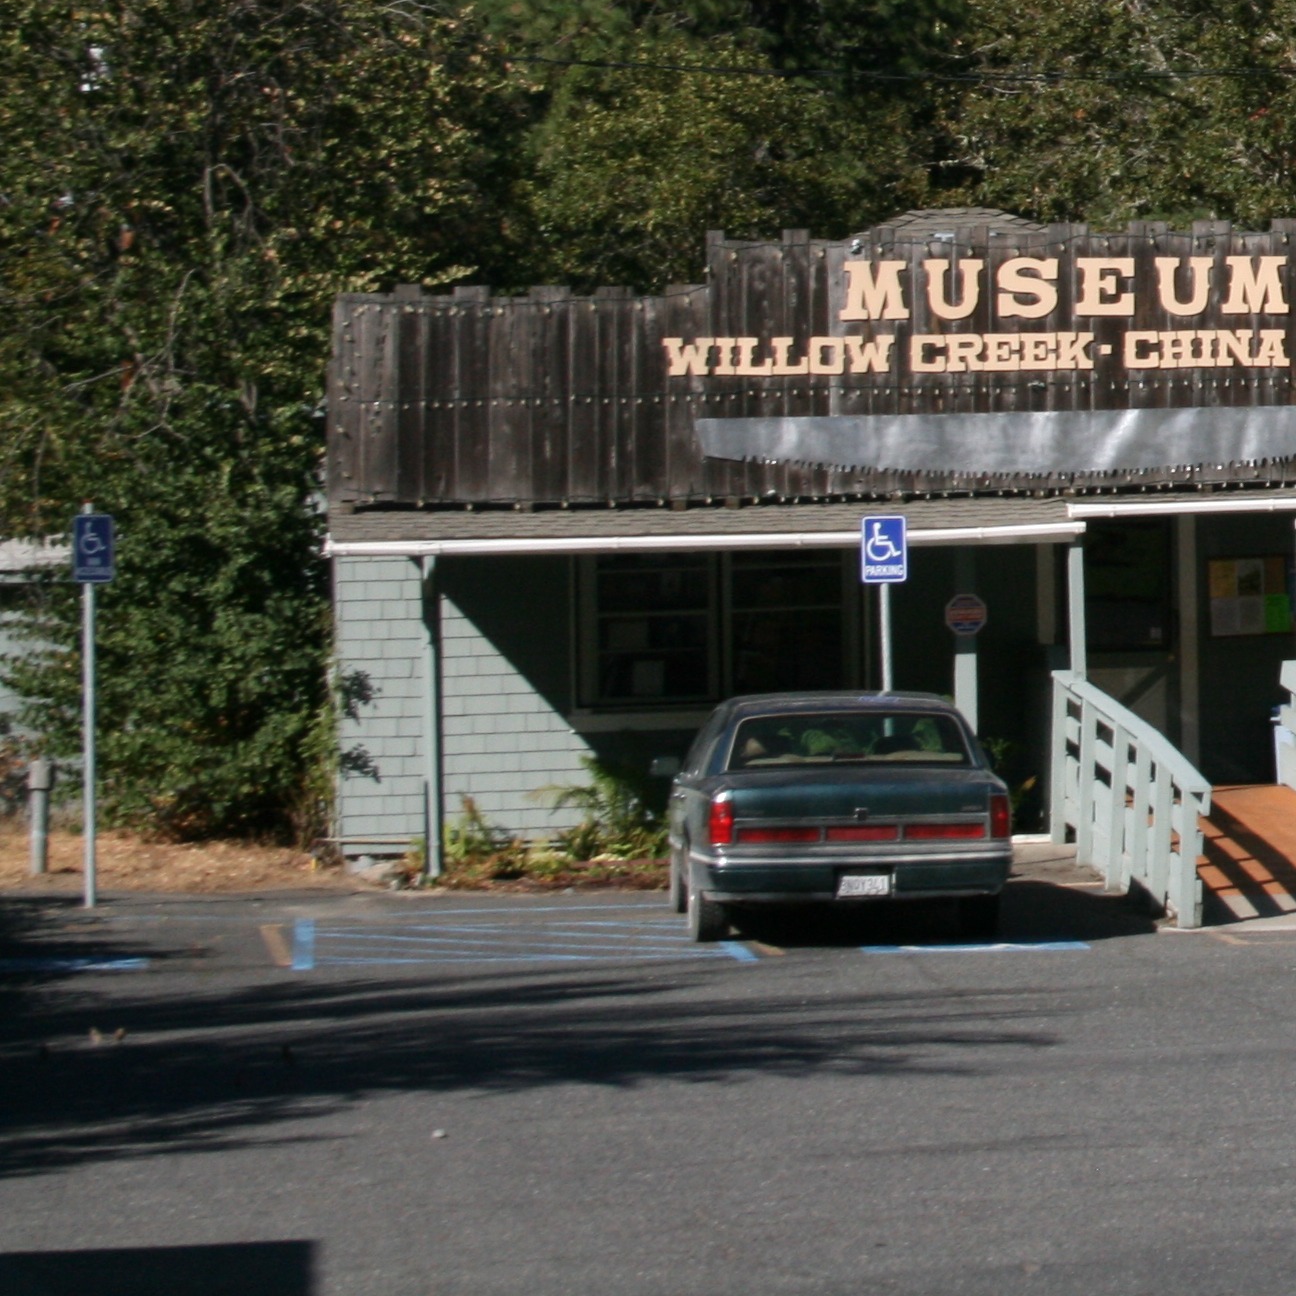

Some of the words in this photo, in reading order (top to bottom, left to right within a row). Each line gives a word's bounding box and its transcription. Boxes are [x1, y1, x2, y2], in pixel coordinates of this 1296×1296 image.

[840, 256, 1290, 322] MUSEUM
[663, 335, 895, 377] WILLOW
[911, 332, 1095, 373] CREEK
[1124, 330, 1291, 370] CHINA
[865, 564, 904, 576] PARKING
